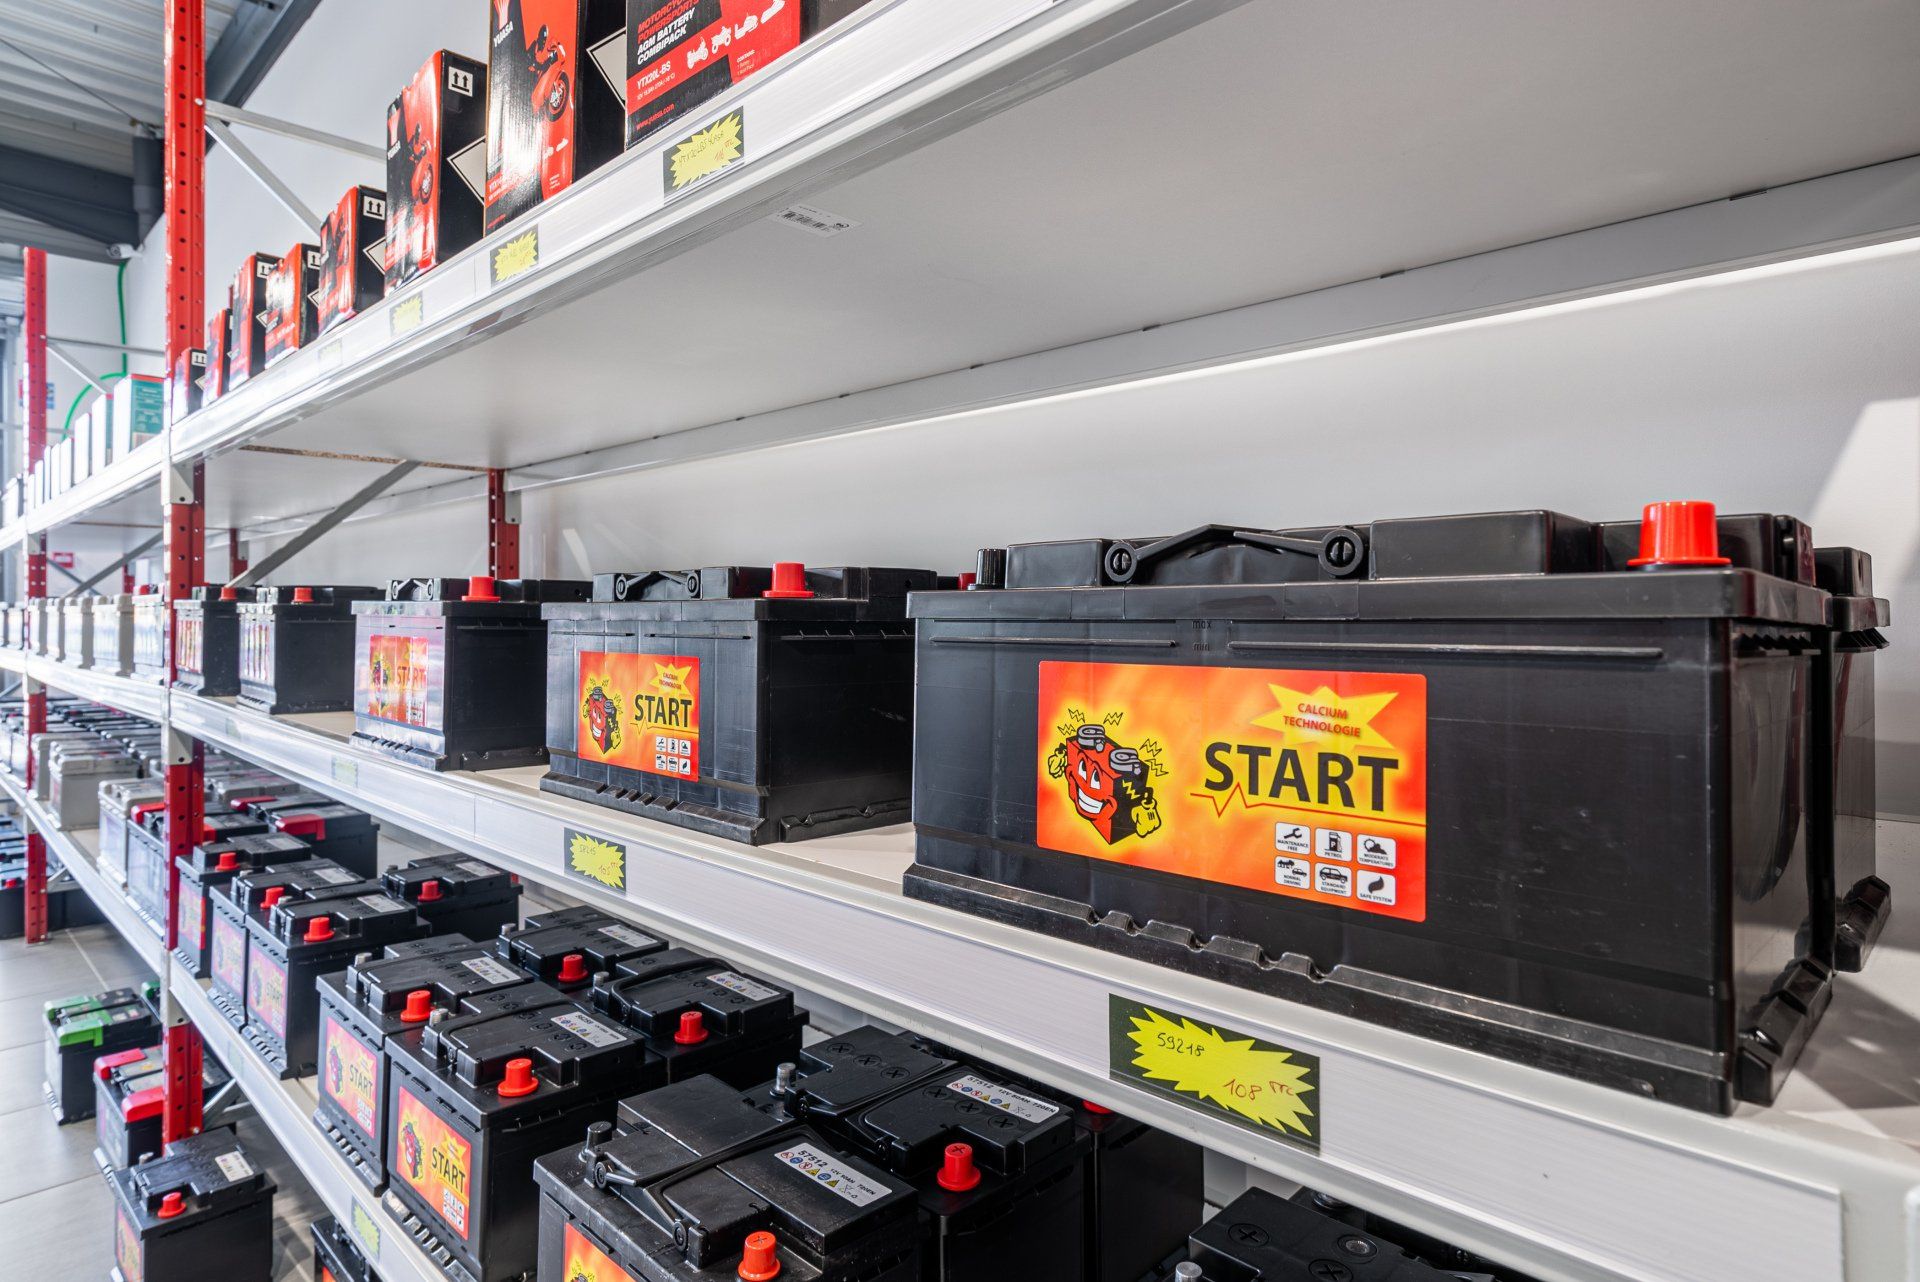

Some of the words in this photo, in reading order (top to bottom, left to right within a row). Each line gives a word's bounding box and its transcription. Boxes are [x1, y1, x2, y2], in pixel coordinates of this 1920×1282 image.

[493, 21, 514, 48] YUASA
[637, 34, 656, 56] AGM
[656, 6, 696, 42] BATTERY
[637, 24, 688, 65] COMBIPACK
[637, 60, 671, 90] YTX20L-BS
[1192, 621, 1212, 630] max
[397, 666, 427, 687] START
[634, 694, 692, 728] START
[1297, 703, 1348, 720] CALCIUM
[1283, 715, 1361, 738] TECHNOLOGIE
[1204, 741, 1399, 812] START
[1277, 839, 1309, 849] MAINTENANCE
[1324, 851, 1343, 859] PETROL
[1283, 874, 1301, 882] NORMAL
[1283, 879, 1301, 887] DRIVING
[1321, 881, 1346, 889] STANDARD
[1320, 886, 1347, 895] EQUIPMENT
[1359, 892, 1372, 900] SAFE
[1372, 895, 1393, 904] SYSTEM
[1157, 1032, 1204, 1057] 59218
[350, 1064, 373, 1100] START
[998, 1088, 1012, 1096] 12V
[1224, 1079, 1263, 1100] 108
[797, 1149, 829, 1168] 57512
[432, 1146, 466, 1194] START
